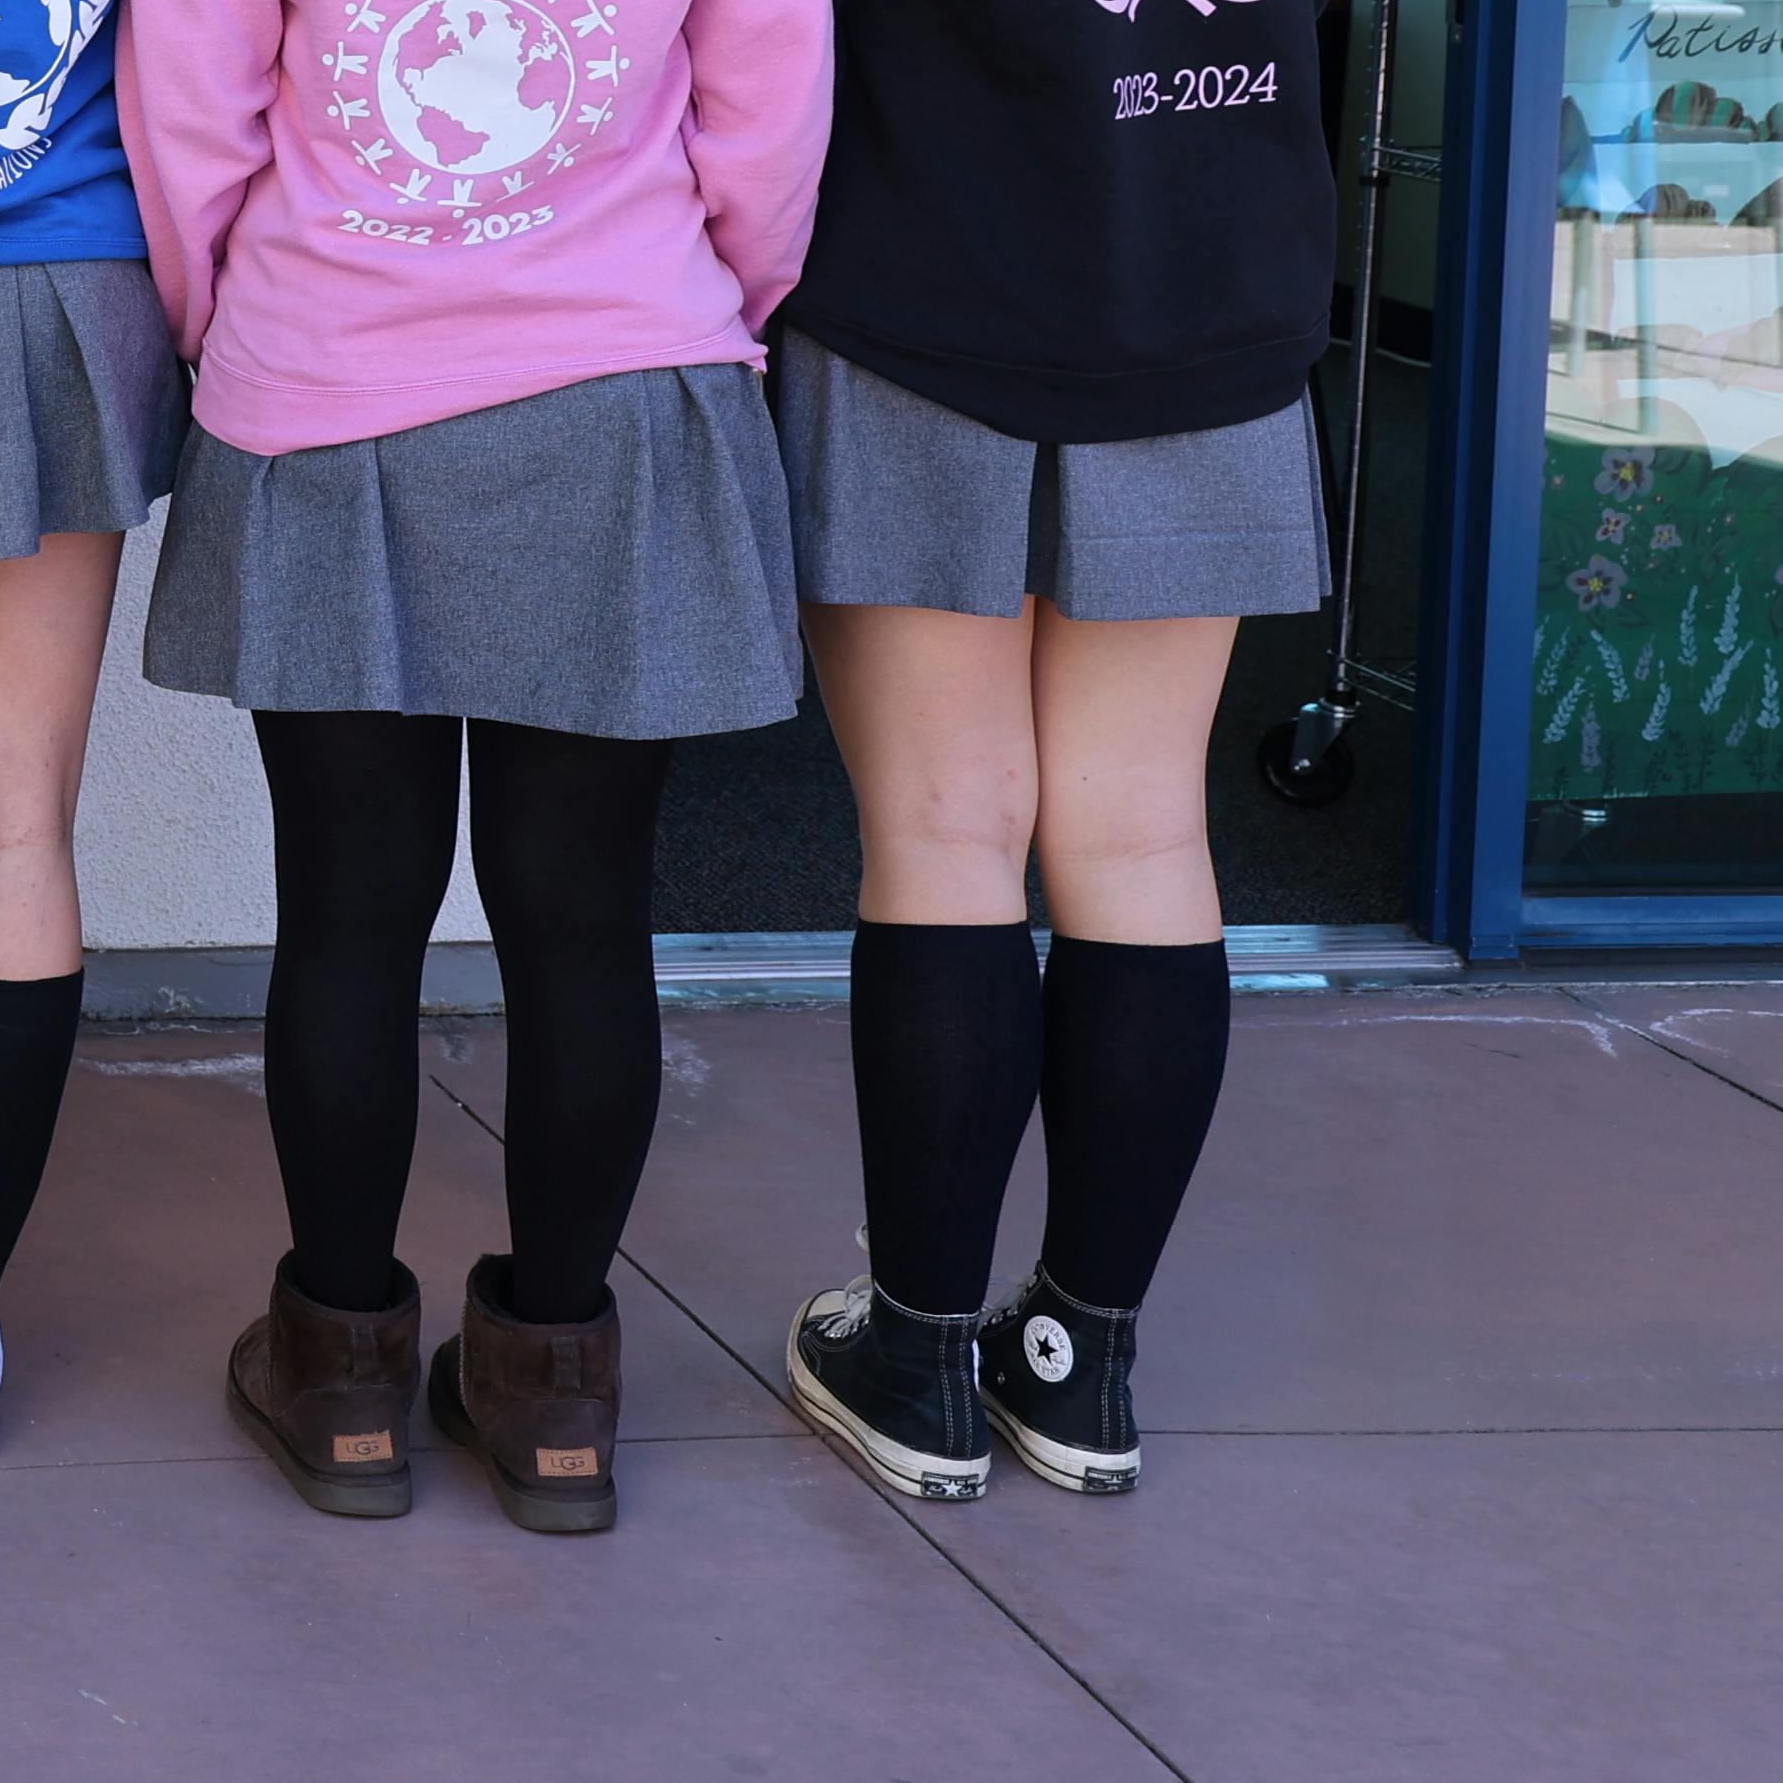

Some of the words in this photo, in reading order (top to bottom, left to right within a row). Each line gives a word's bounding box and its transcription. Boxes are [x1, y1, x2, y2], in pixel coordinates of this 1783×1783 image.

[1618, 6, 1783, 63] Patiss
[1113, 62, 1279, 120] 2023-2024
[336, 209, 434, 246] 2022
[461, 205, 555, 246] 2023
[345, 1440, 379, 1455] UGG
[551, 1455, 585, 1470] UGG
